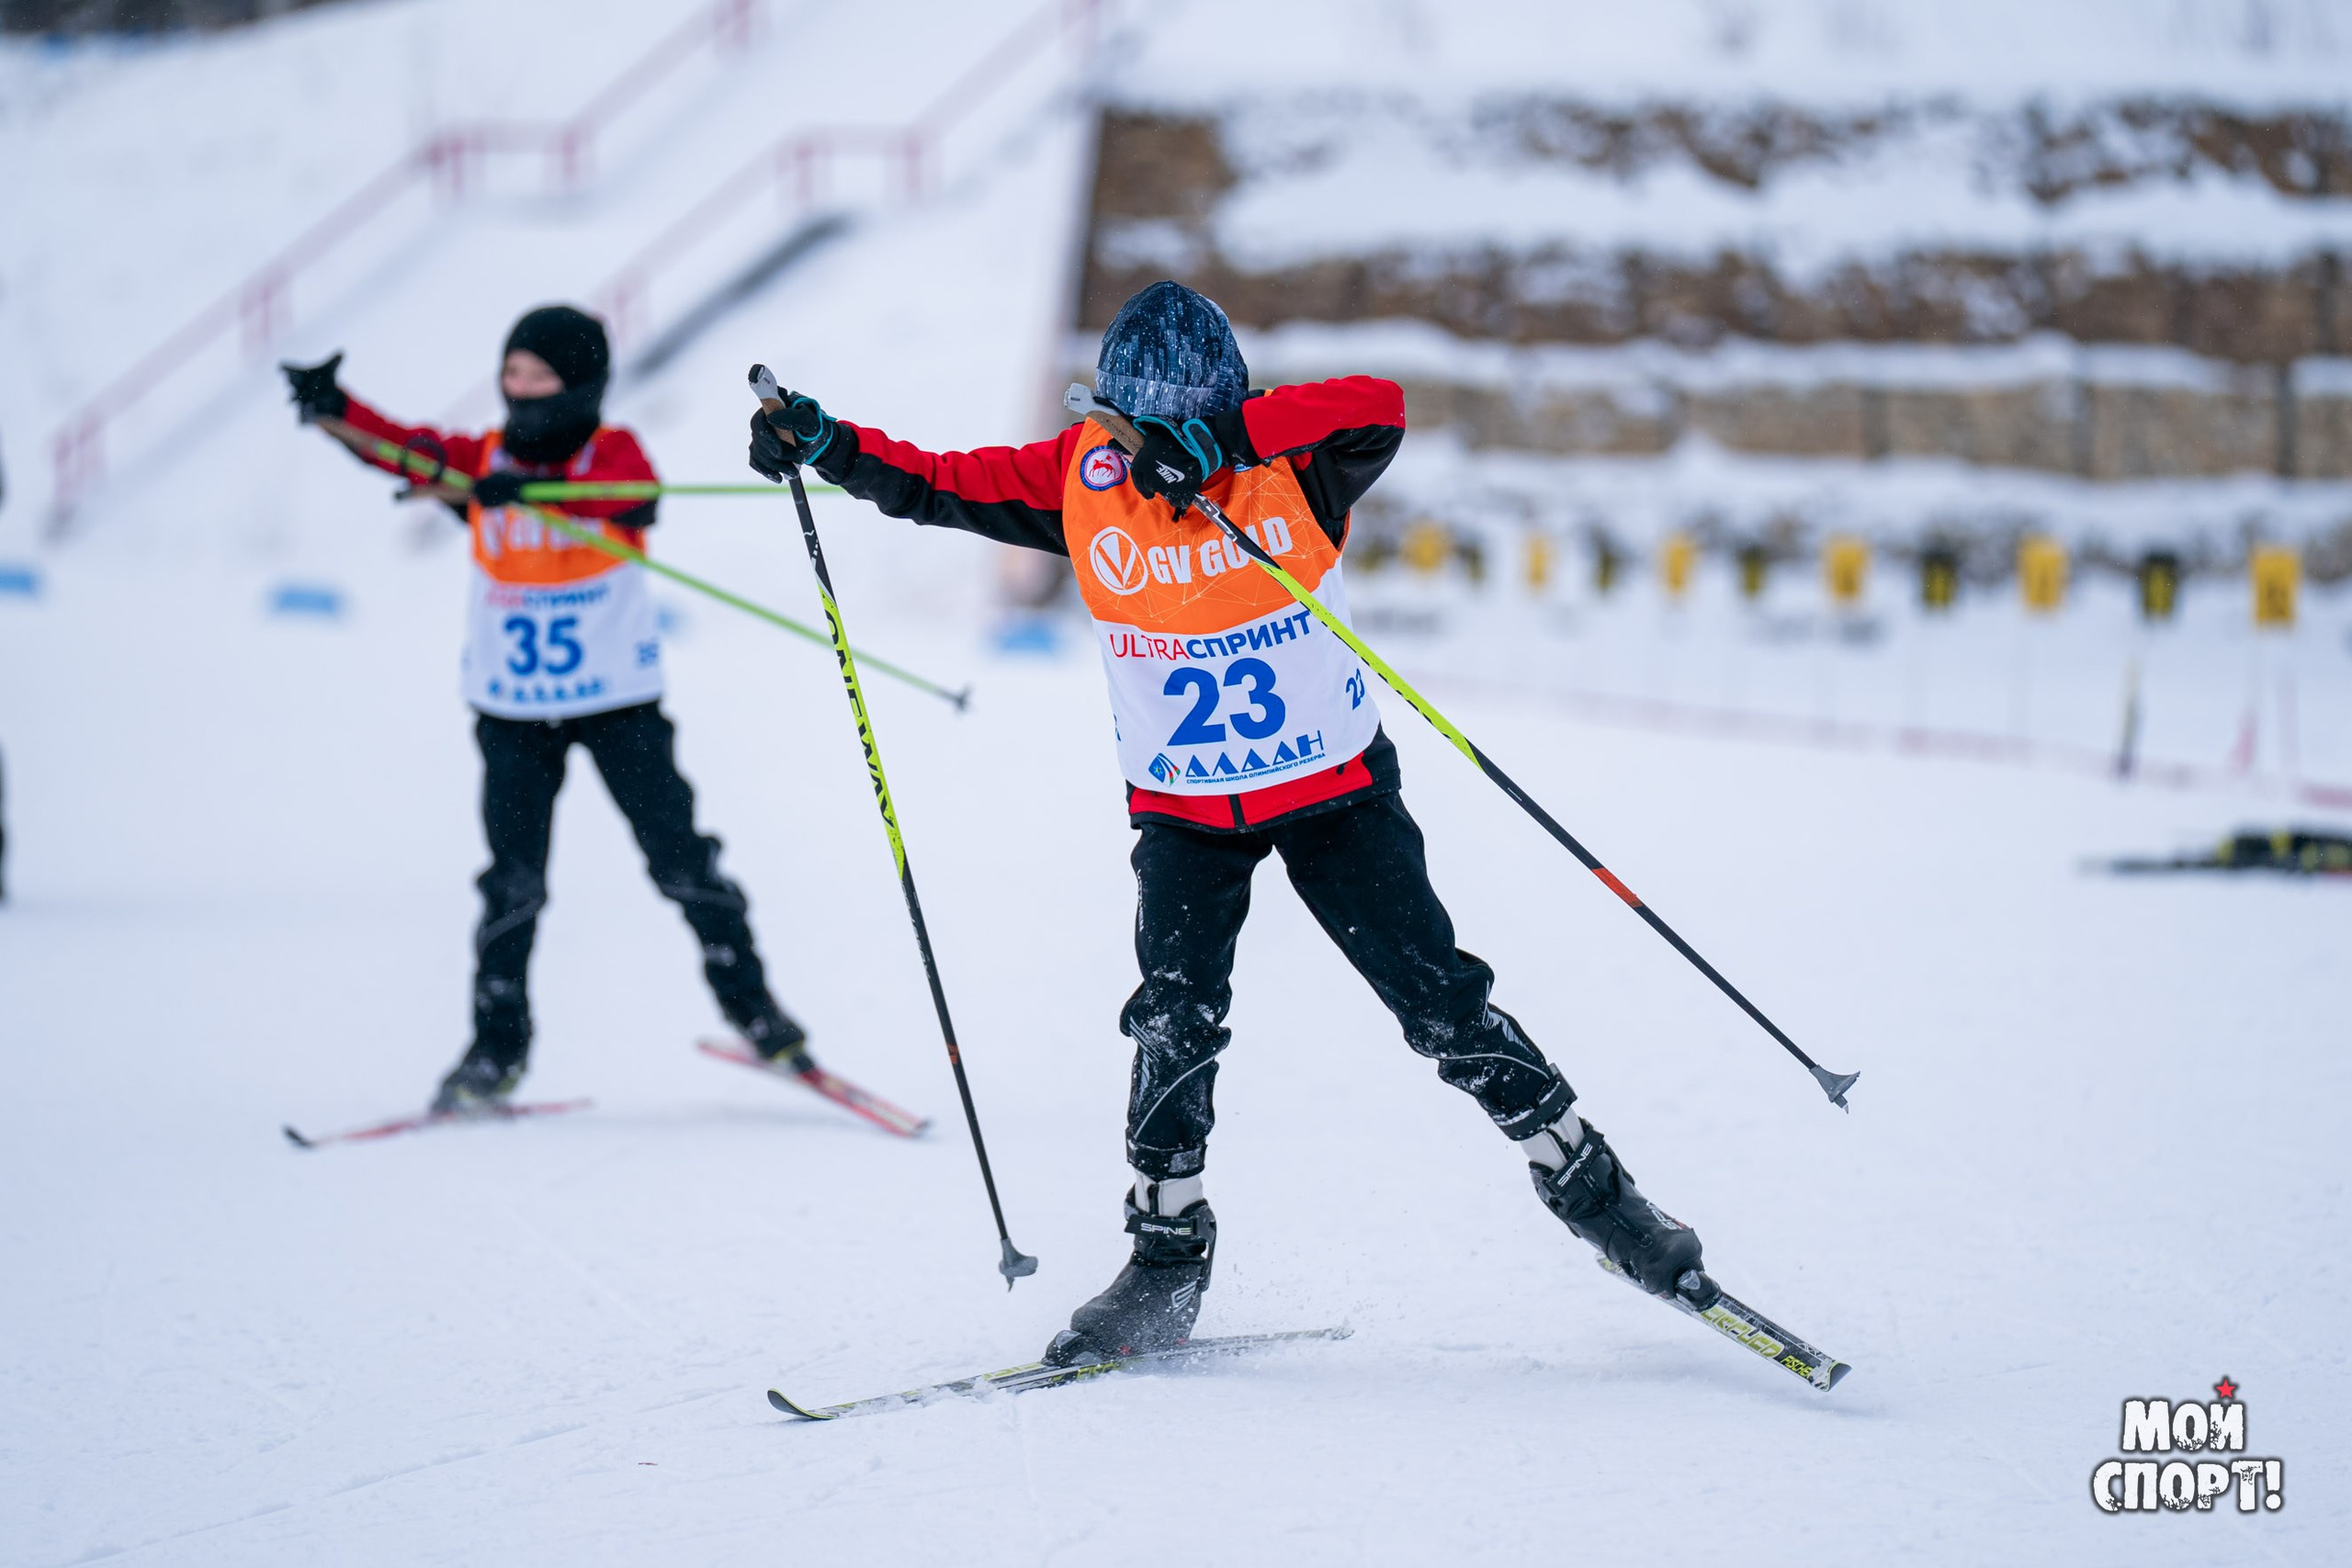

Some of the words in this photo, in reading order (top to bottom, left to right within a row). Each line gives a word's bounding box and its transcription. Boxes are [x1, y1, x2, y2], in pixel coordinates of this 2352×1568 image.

[1156, 466, 1177, 484] NIKE
[1147, 545, 1193, 585] GV
[1200, 516, 1293, 577] GOLD
[503, 615, 583, 676] 35
[1162, 657, 1286, 747] 23
[1345, 667, 1366, 711] 23
[1184, 729, 1324, 778] АЛДАН
[1225, 774, 1249, 783] ШКОЛА
[1249, 761, 1299, 779] ОЛИМПИЙСКОГО
[1299, 752, 1327, 766] РЕЗЕРВА
[1557, 1142, 1593, 1188] SPINE
[1140, 1222, 1192, 1235] SPINE
